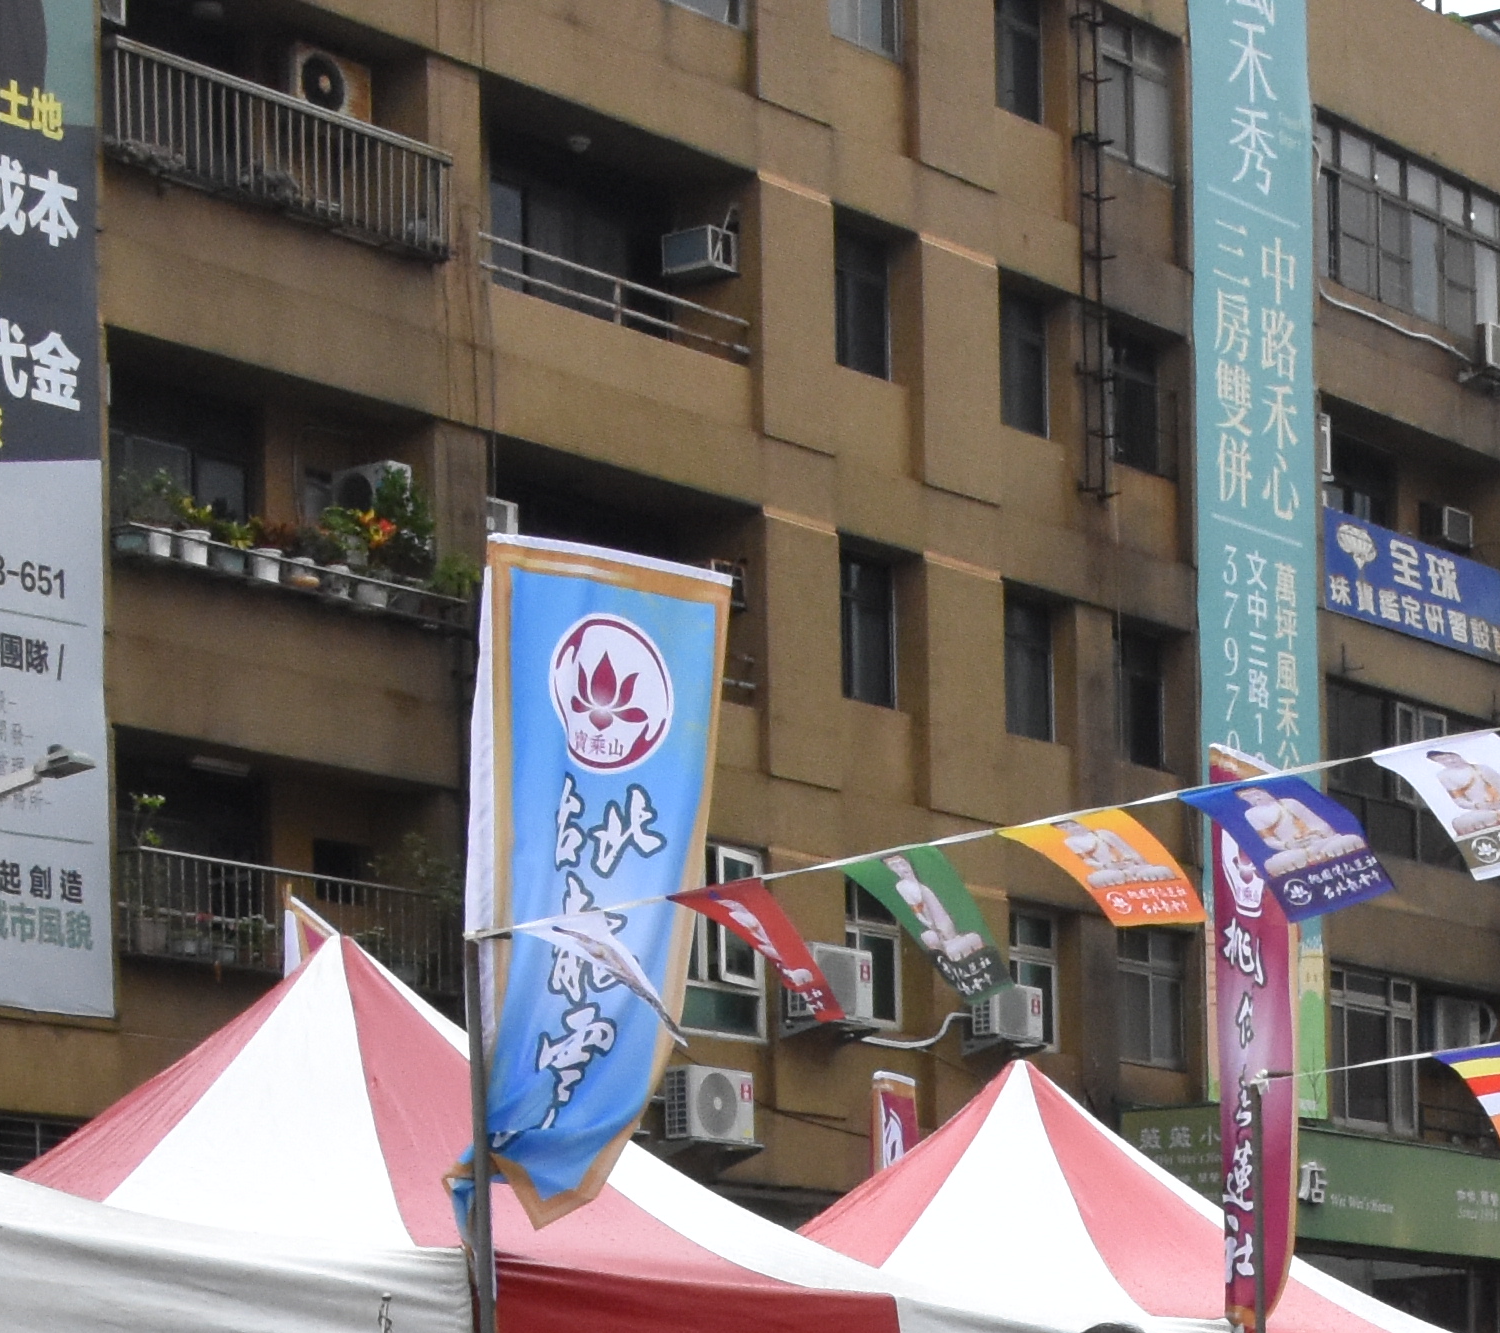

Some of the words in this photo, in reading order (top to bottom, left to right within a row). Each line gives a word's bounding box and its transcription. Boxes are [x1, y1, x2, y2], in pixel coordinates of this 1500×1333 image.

[1261, 237, 1299, 521] 中路禾心
[1389, 538, 1461, 602] 全球
[574, 730, 625, 759] 寶乘山
